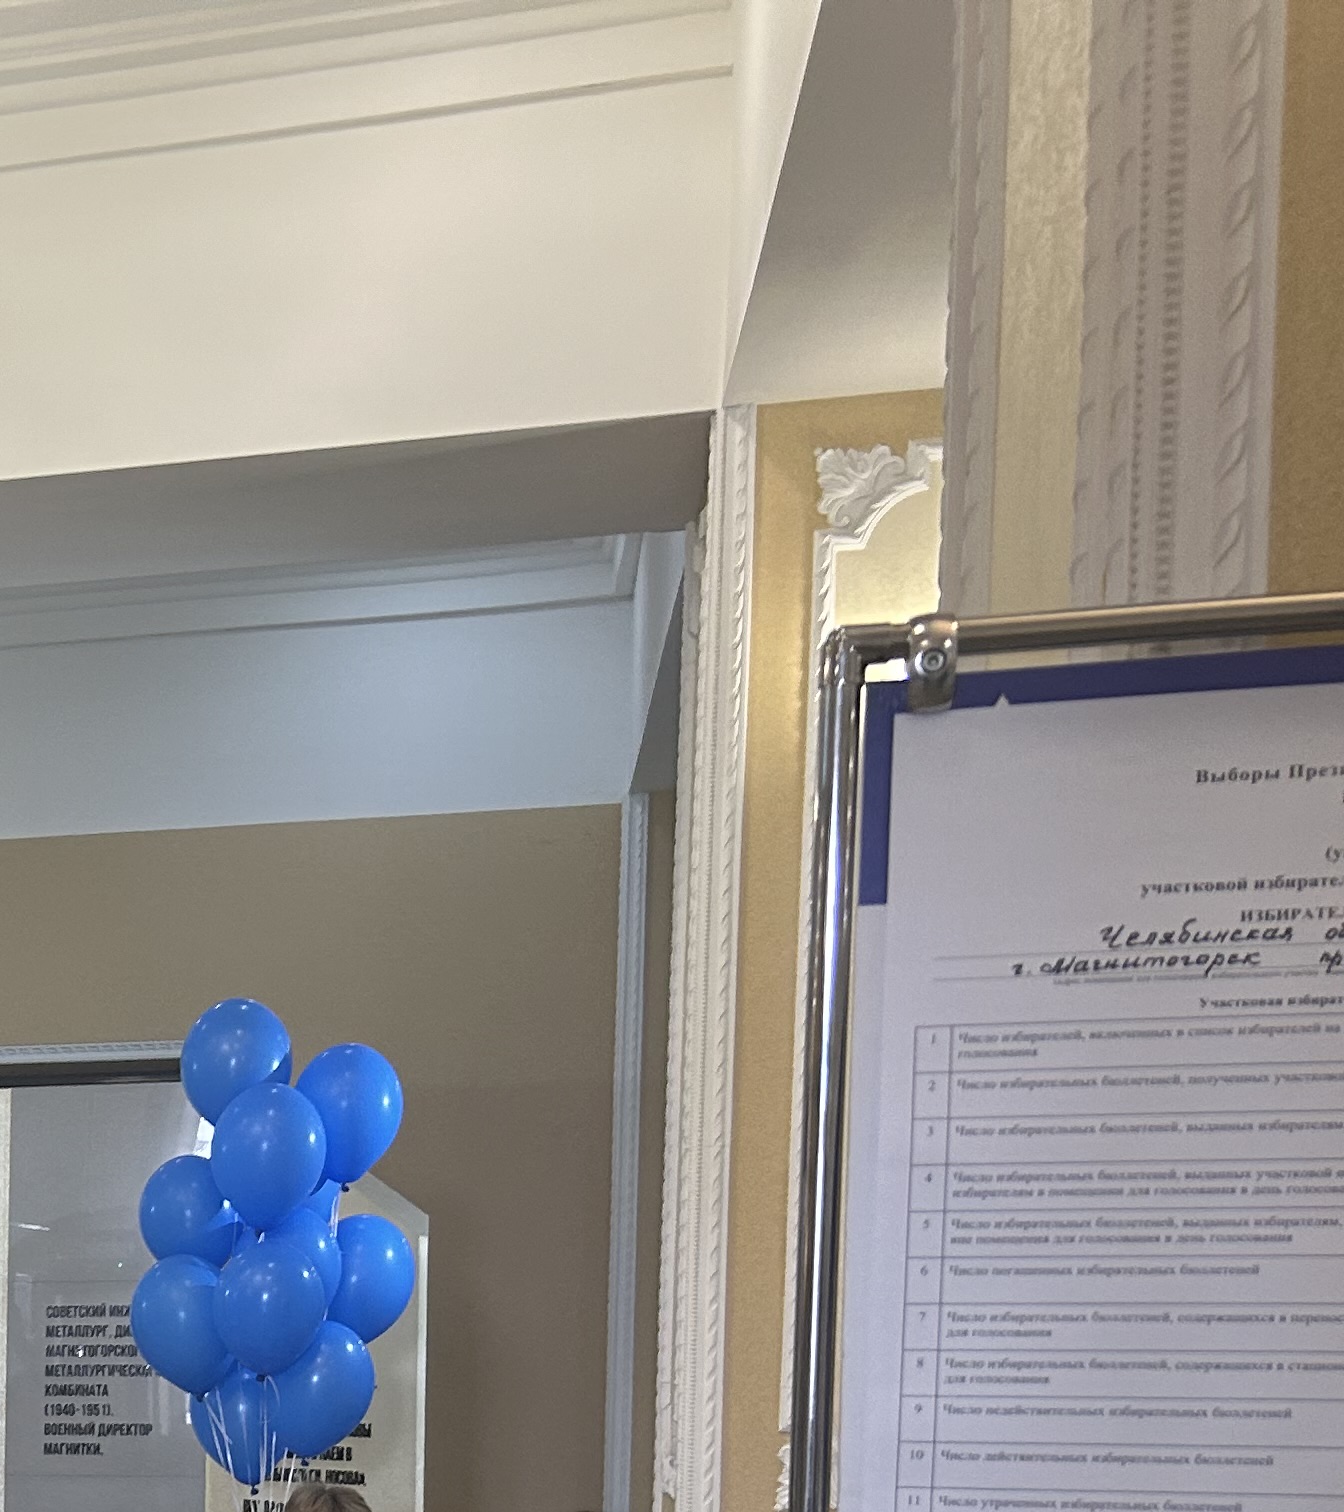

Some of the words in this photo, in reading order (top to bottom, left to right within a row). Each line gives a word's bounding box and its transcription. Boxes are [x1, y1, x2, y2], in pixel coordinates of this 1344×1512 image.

[1195, 765, 1280, 785] Выборы
[1140, 876, 1248, 899] участковой
[1240, 906, 1344, 922] ИЗБИРАТЕ
[1099, 917, 1294, 949] Челябинская
[1039, 950, 1261, 979] Магнитогорск
[1199, 997, 1284, 1009] Участковая
[45, 1303, 107, 1319] СОВЕТСКИЙ
[109, 1304, 130, 1318] ИНЖ
[114, 1324, 134, 1339] ДИ
[45, 1344, 138, 1358] МАГНИТОГОРСКО
[44, 1383, 109, 1397] КОМБИНАТА
[43, 1421, 95, 1436] ВОЕННЫЙ
[98, 1422, 153, 1438] ДИРЕКТОР
